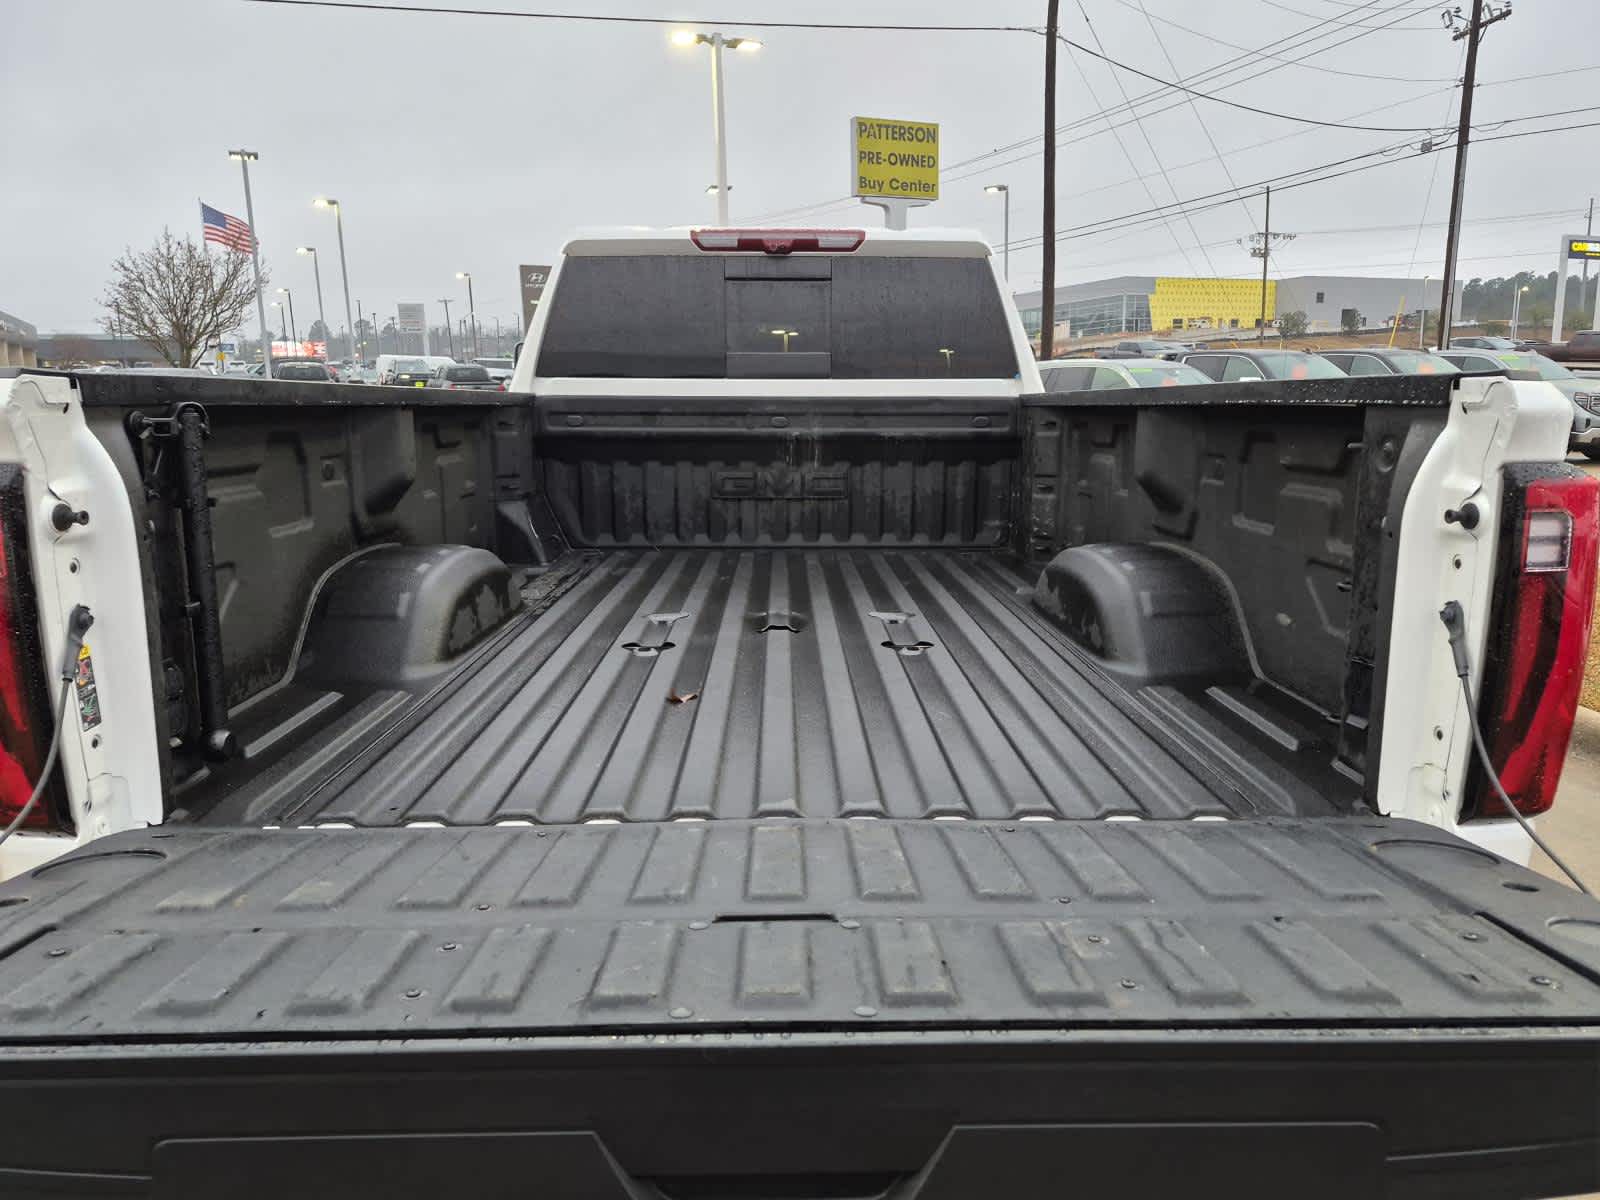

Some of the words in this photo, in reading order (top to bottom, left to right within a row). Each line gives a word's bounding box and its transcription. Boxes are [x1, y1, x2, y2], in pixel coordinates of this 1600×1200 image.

[857, 122, 936, 143] PATTERSON
[859, 151, 936, 168] PRE-OWNED
[859, 176, 884, 192] Buy
[889, 178, 936, 193] Center
[712, 471, 848, 498] GMC
